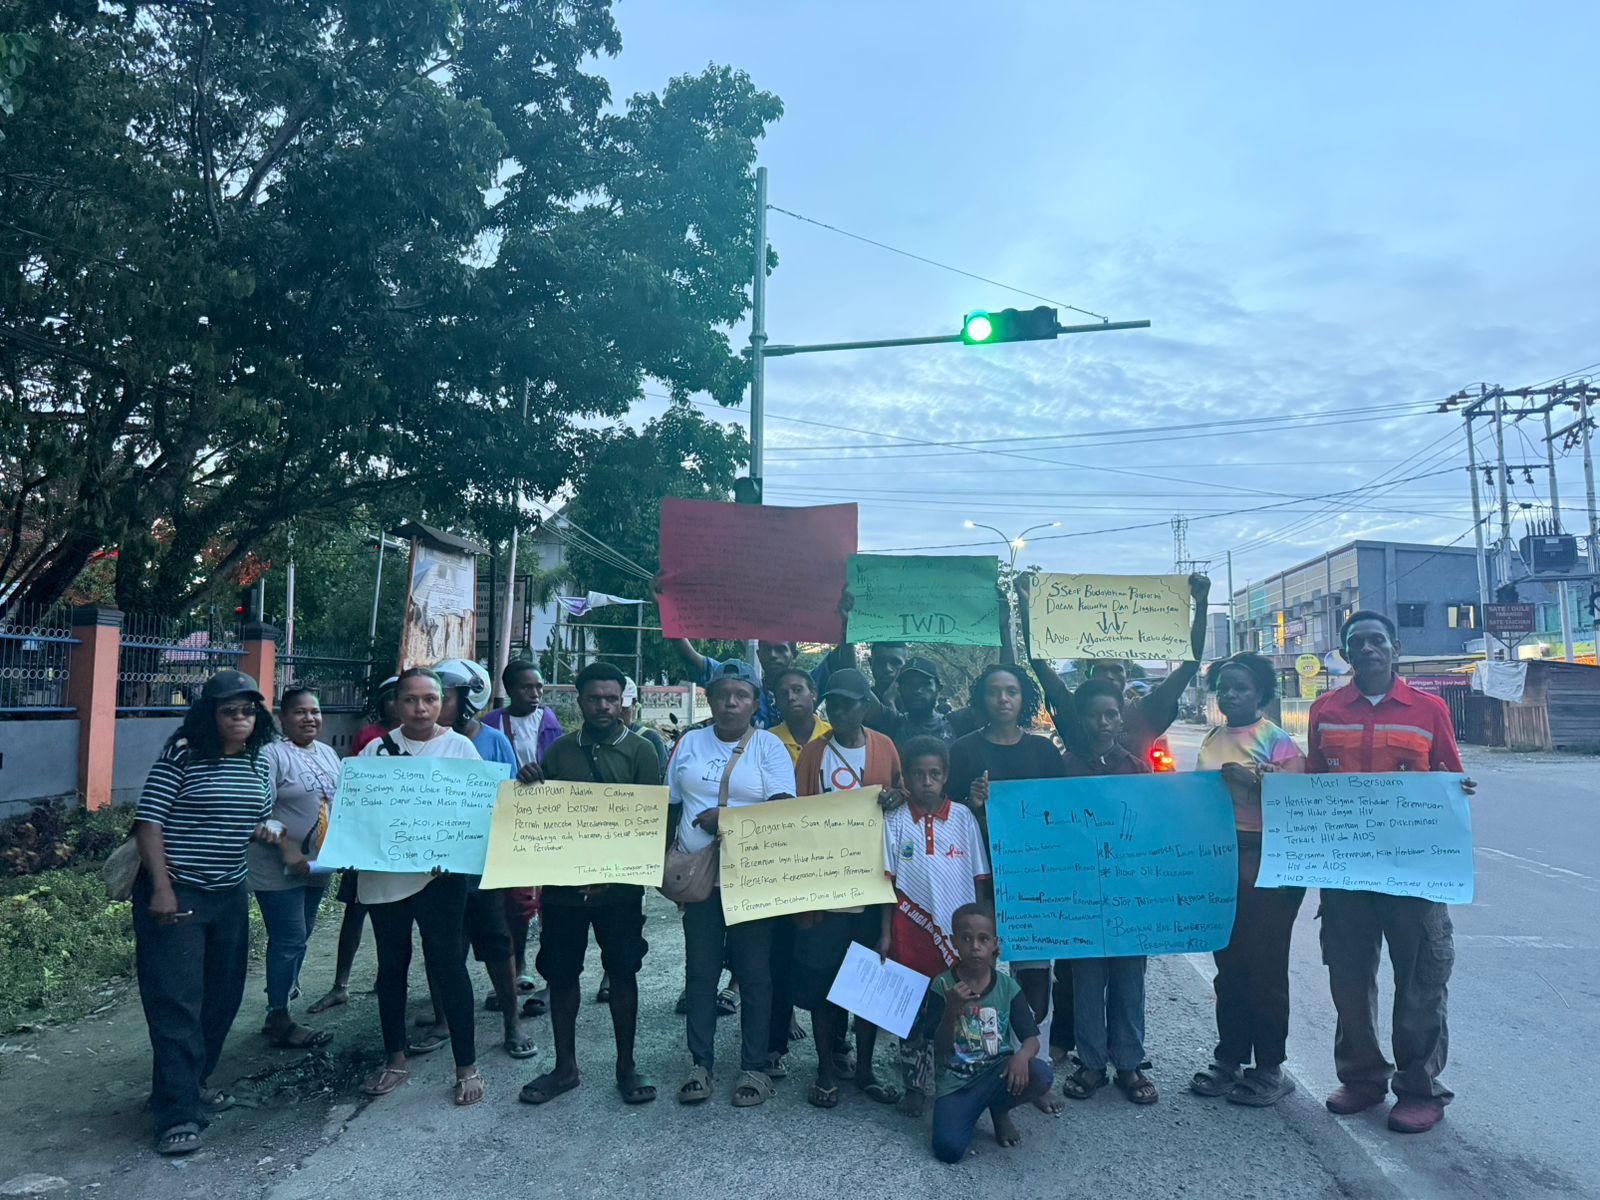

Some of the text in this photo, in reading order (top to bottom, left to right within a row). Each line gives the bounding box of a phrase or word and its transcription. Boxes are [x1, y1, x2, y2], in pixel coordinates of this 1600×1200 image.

[1112, 600, 1129, 611] Dan
[899, 612, 956, 635] IWD
[393, 768, 425, 781] Stigma
[1347, 775, 1404, 788] Bersuara
[1284, 796, 1323, 807] Hentikan
[1325, 796, 1355, 806] Stigma
[511, 801, 533, 816] Yang
[1359, 807, 1374, 817] HIV
[740, 818, 796, 840] Dengarkan
[1286, 821, 1318, 834] Lindungi
[1284, 834, 1316, 845] Terkait
[1321, 832, 1335, 844] HIV
[1352, 831, 1376, 842] AIDS
[738, 841, 760, 854] Tanah
[1287, 861, 1301, 872] HIV
[1322, 860, 1347, 872] AIDS
[1284, 874, 1304, 883] IWD
